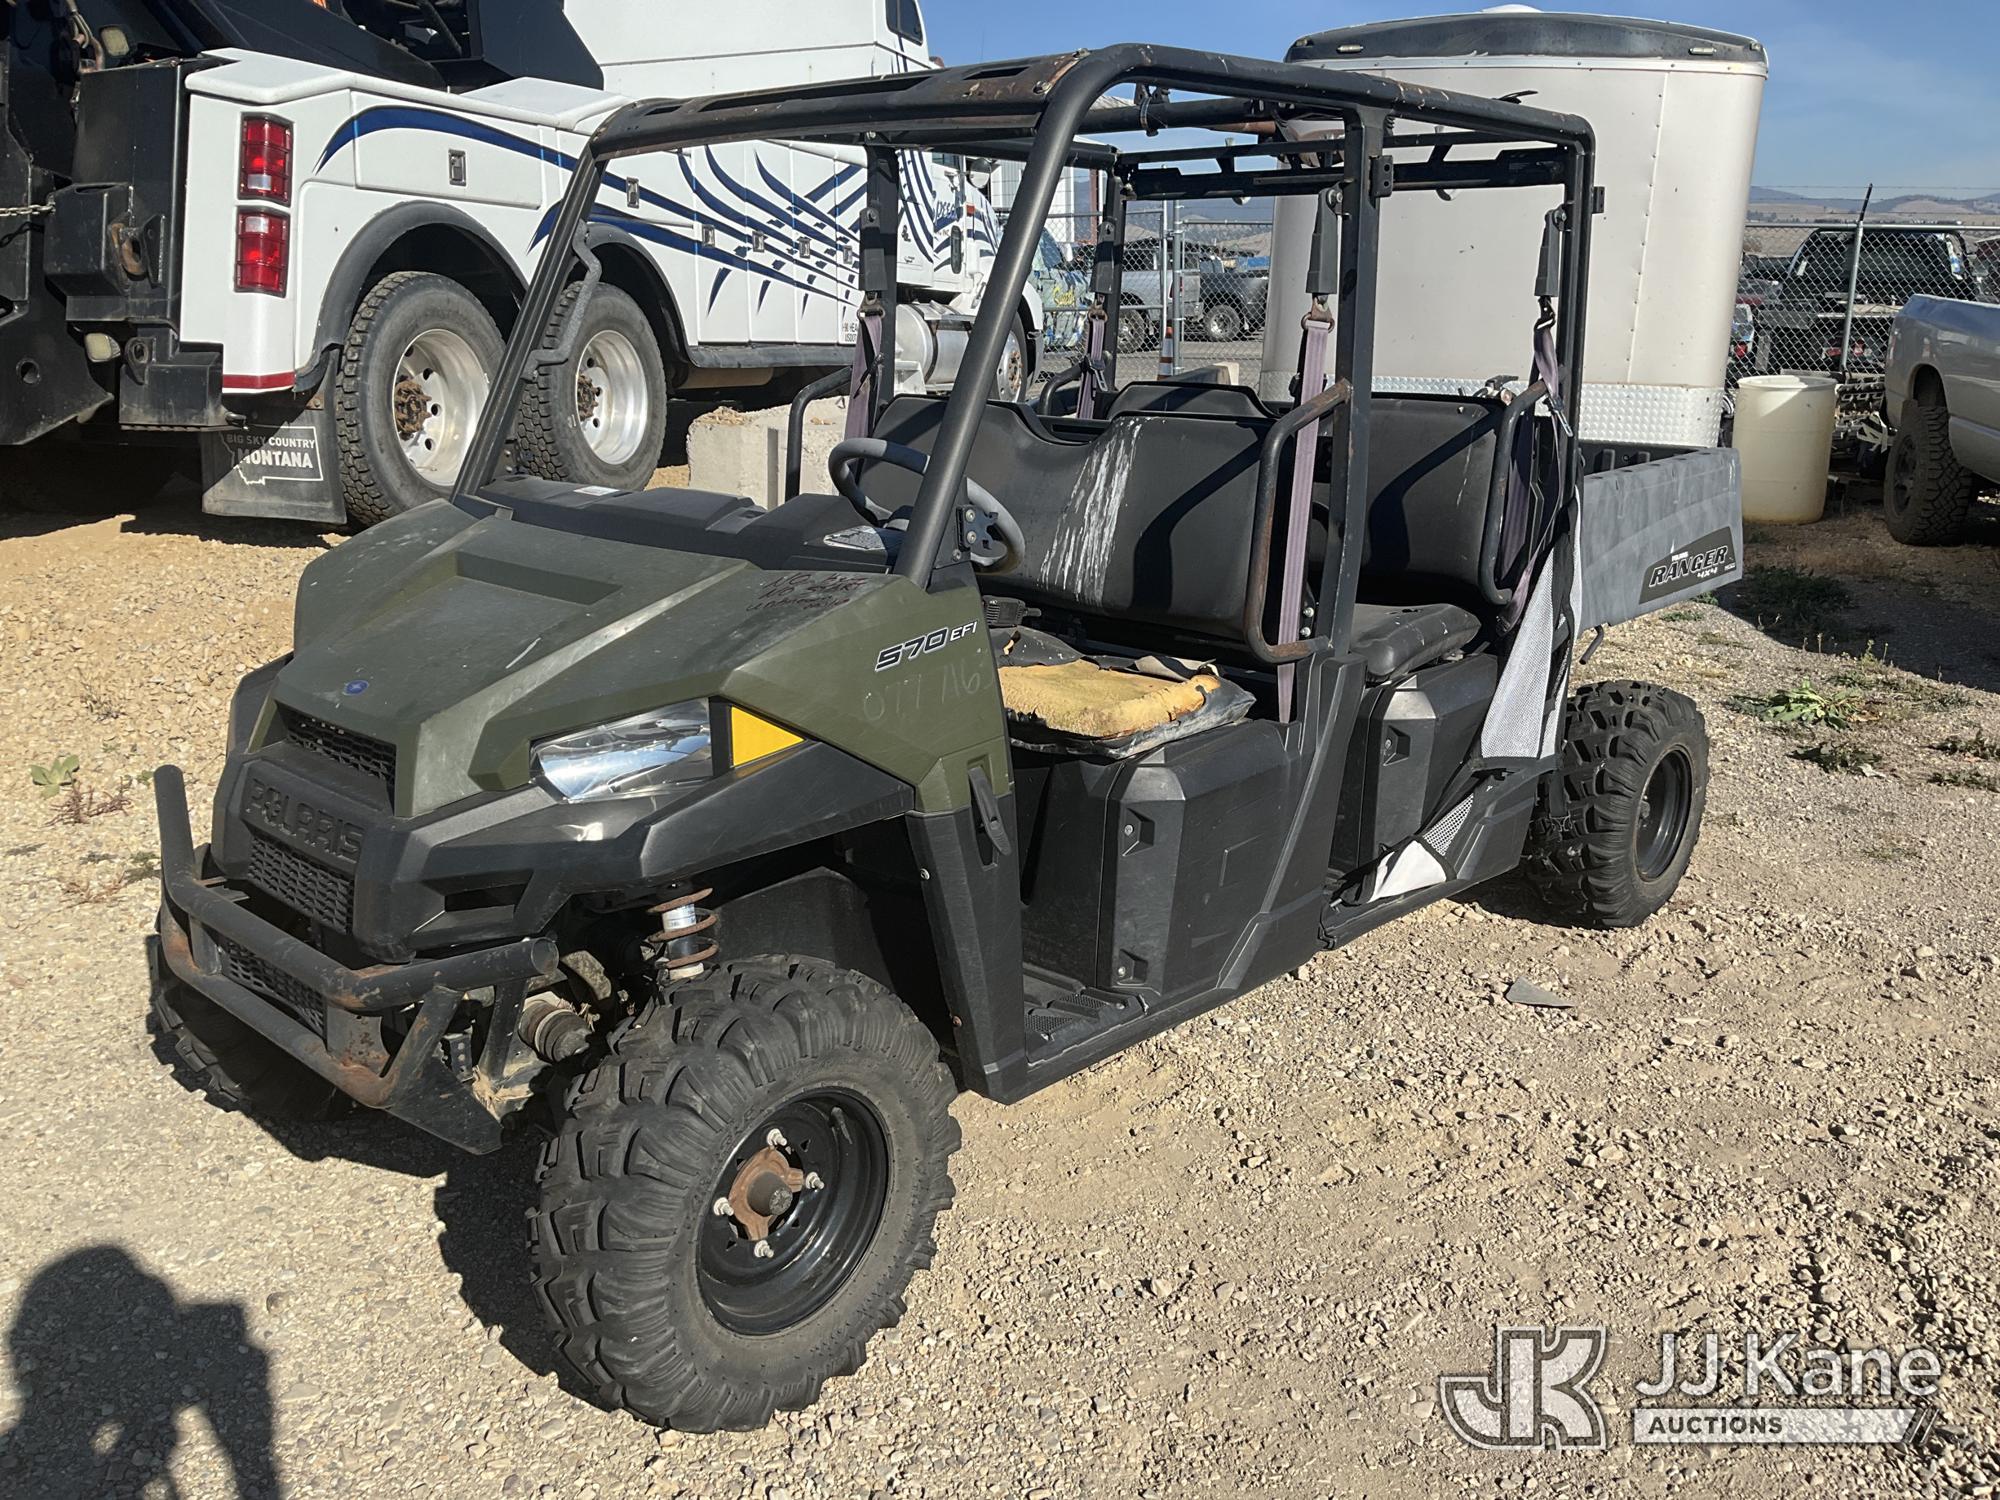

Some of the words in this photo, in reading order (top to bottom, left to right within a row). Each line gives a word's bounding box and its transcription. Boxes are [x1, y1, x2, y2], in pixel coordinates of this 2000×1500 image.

[226, 433, 244, 443] BIG
[246, 435, 266, 445] SKY
[268, 437, 315, 449] COUNTRY
[237, 448, 314, 469] MONTANA
[1648, 545, 1728, 587] RANGER
[874, 626, 949, 673] 570
[949, 620, 979, 642] EFI
[247, 778, 365, 864] POLARIS
